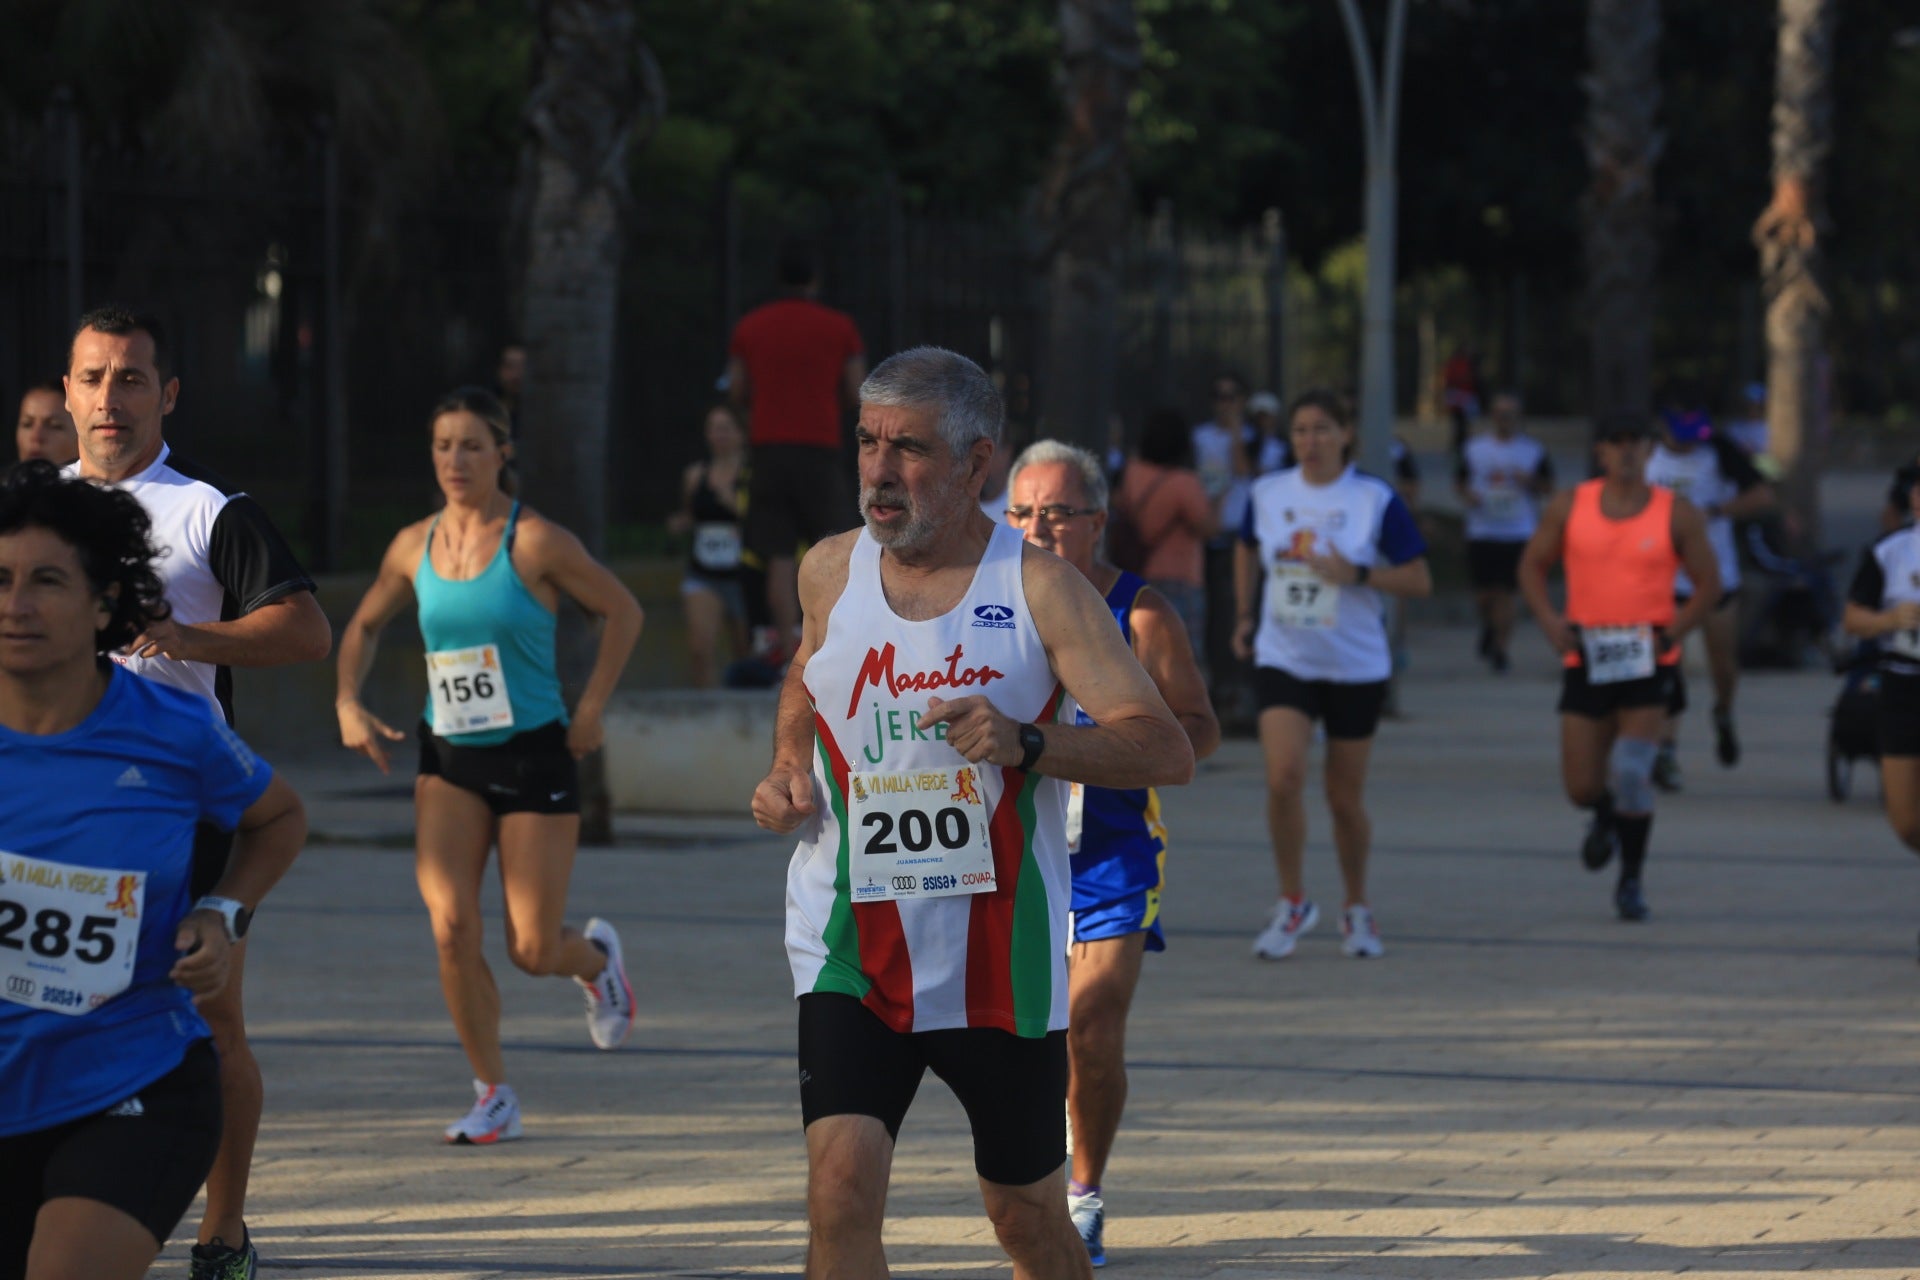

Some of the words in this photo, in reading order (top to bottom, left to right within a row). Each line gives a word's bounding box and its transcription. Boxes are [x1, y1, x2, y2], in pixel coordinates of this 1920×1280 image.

[1287, 581, 1321, 606] 57
[439, 673, 494, 704] 156
[847, 641, 1005, 720] Maraton
[868, 775, 881, 795] VII
[883, 775, 913, 794] MILLA
[914, 773, 949, 792] VERDE
[862, 807, 970, 855] 200
[896, 857, 944, 866] JUANSANCHEZ
[9, 860, 25, 883] VII
[26, 863, 64, 890] MILLA
[67, 871, 109, 895] VERDE
[962, 871, 991, 886] COVAP
[0, 900, 118, 965] 285
